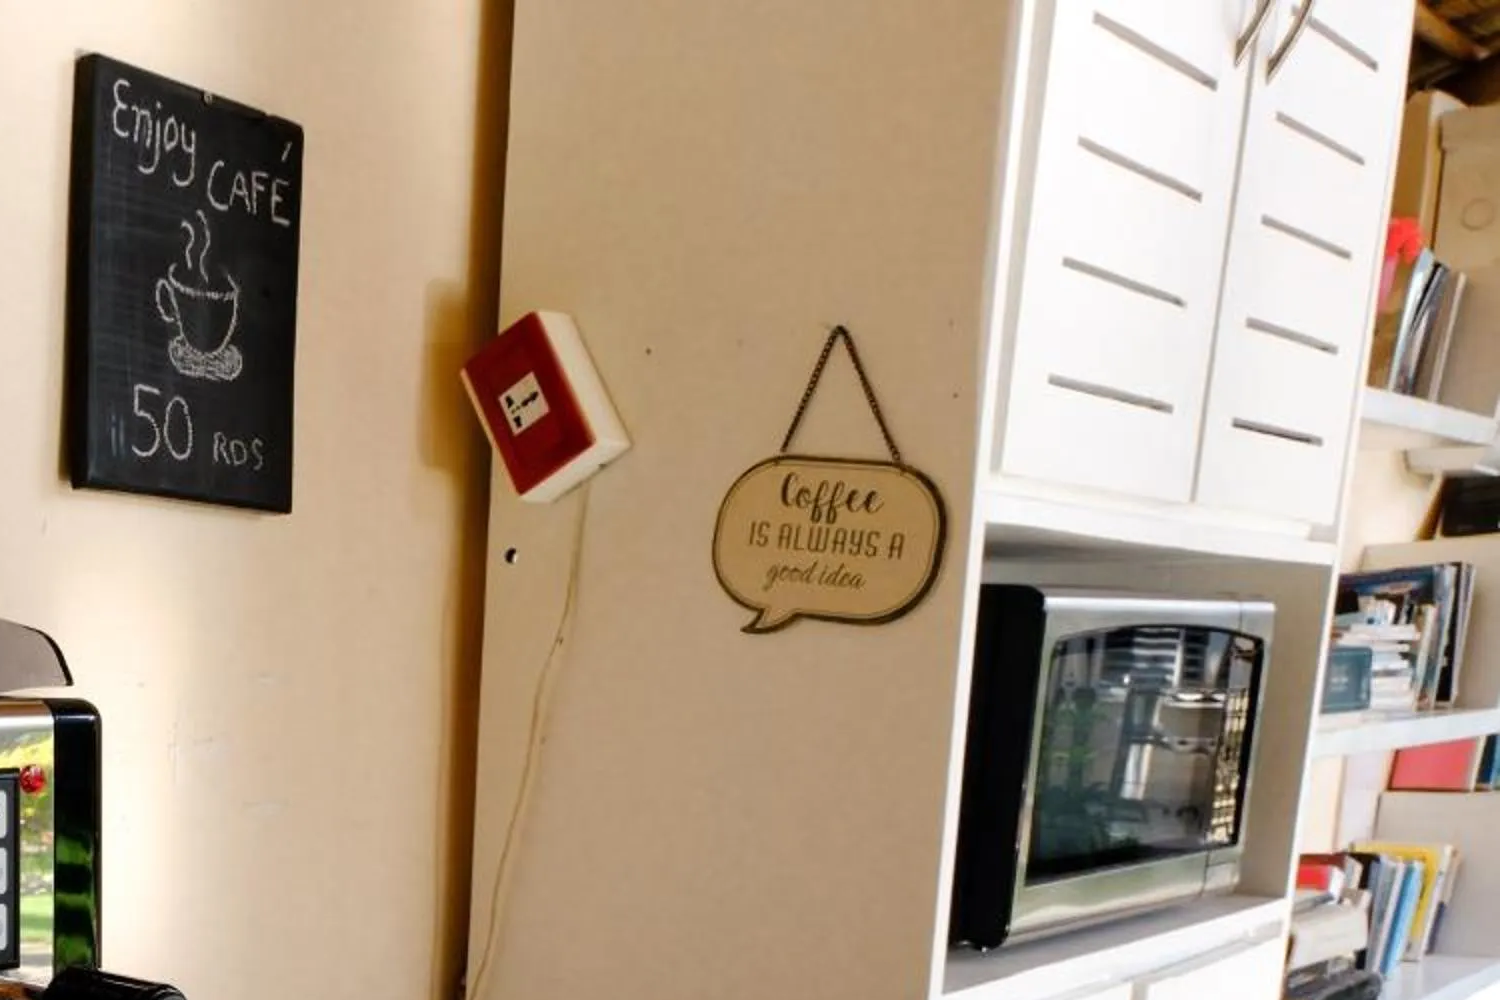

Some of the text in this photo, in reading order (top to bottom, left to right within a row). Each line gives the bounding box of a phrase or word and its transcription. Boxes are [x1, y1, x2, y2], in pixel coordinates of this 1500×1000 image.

[112, 78, 197, 187] Enjoy
[131, 383, 194, 461] 50
[780, 471, 886, 525] Coffee
[748, 520, 906, 560] IS ALWAYS A
[761, 559, 867, 593] good idea
